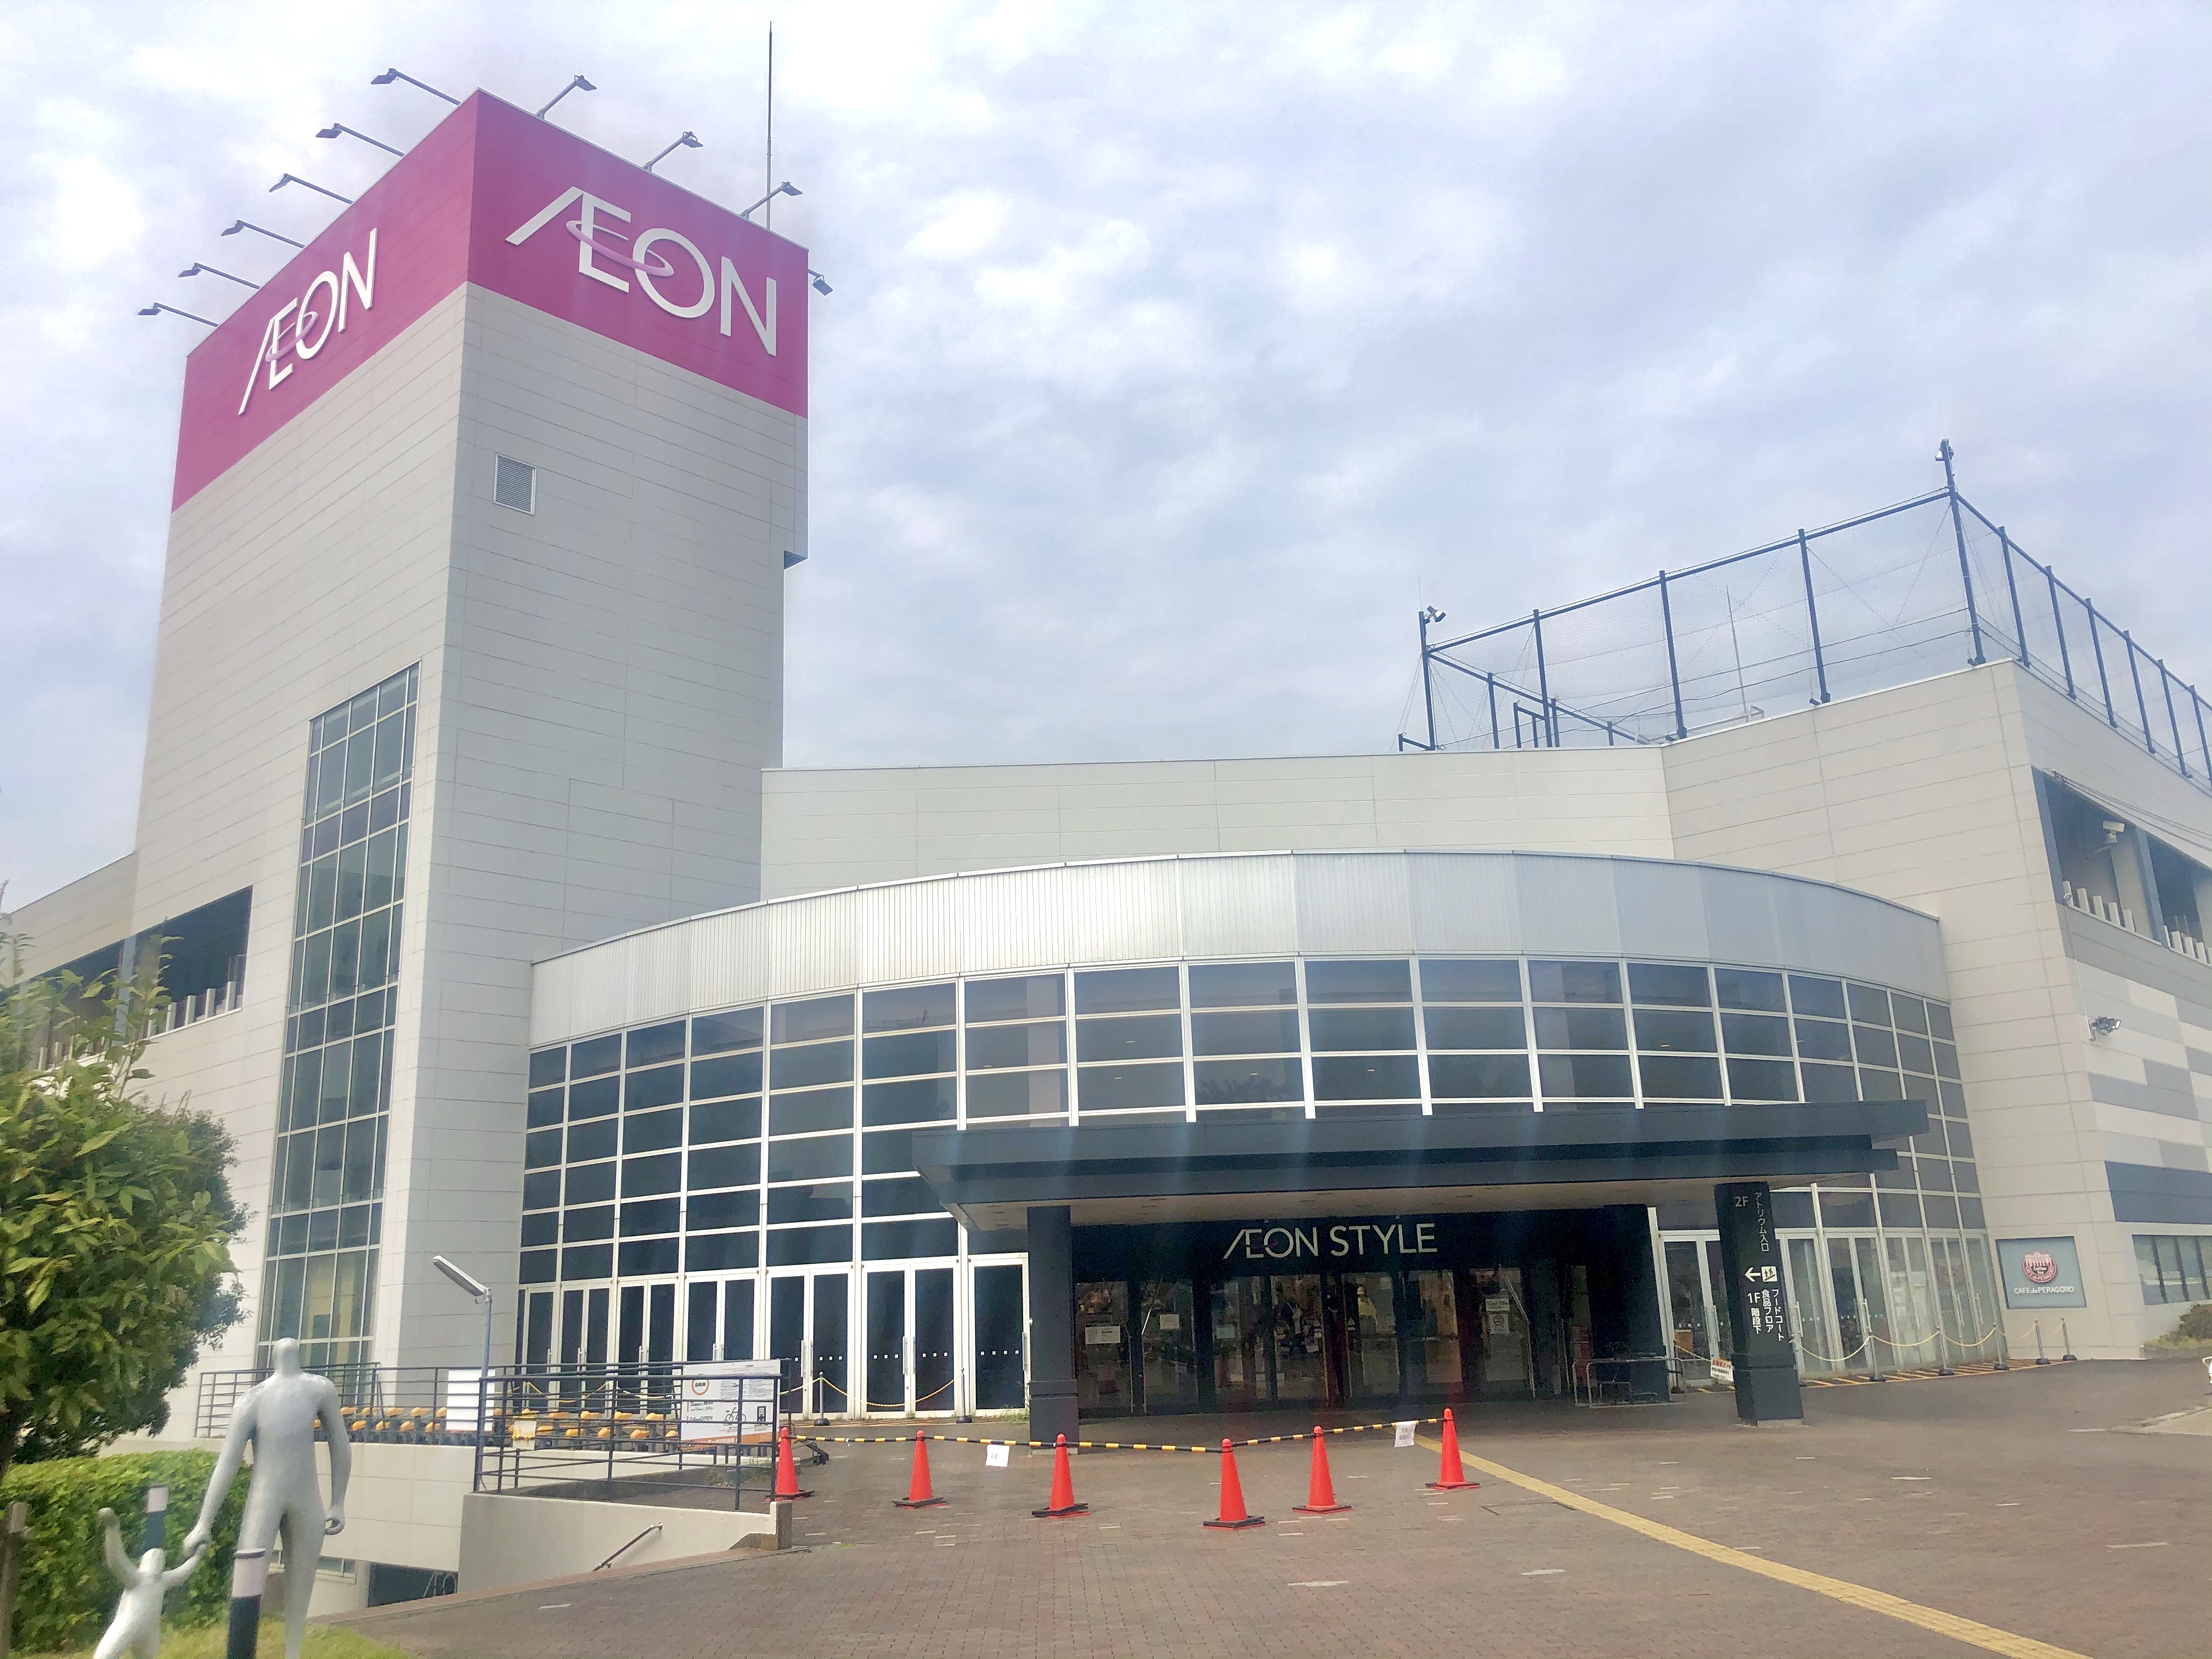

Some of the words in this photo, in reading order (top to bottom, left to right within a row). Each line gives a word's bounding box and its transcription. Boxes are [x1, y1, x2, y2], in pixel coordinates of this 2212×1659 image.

[1734, 1196, 1748, 1207] 2F
[1755, 1192, 1769, 1251] アトリウム入口
[1329, 1223, 1438, 1256] STYLE
[1747, 1292, 1760, 1304] 1F
[1761, 1289, 1774, 1333] 食品フロア
[1751, 1307, 1762, 1334] 階段下
[1771, 1289, 1785, 1342] フードコート
